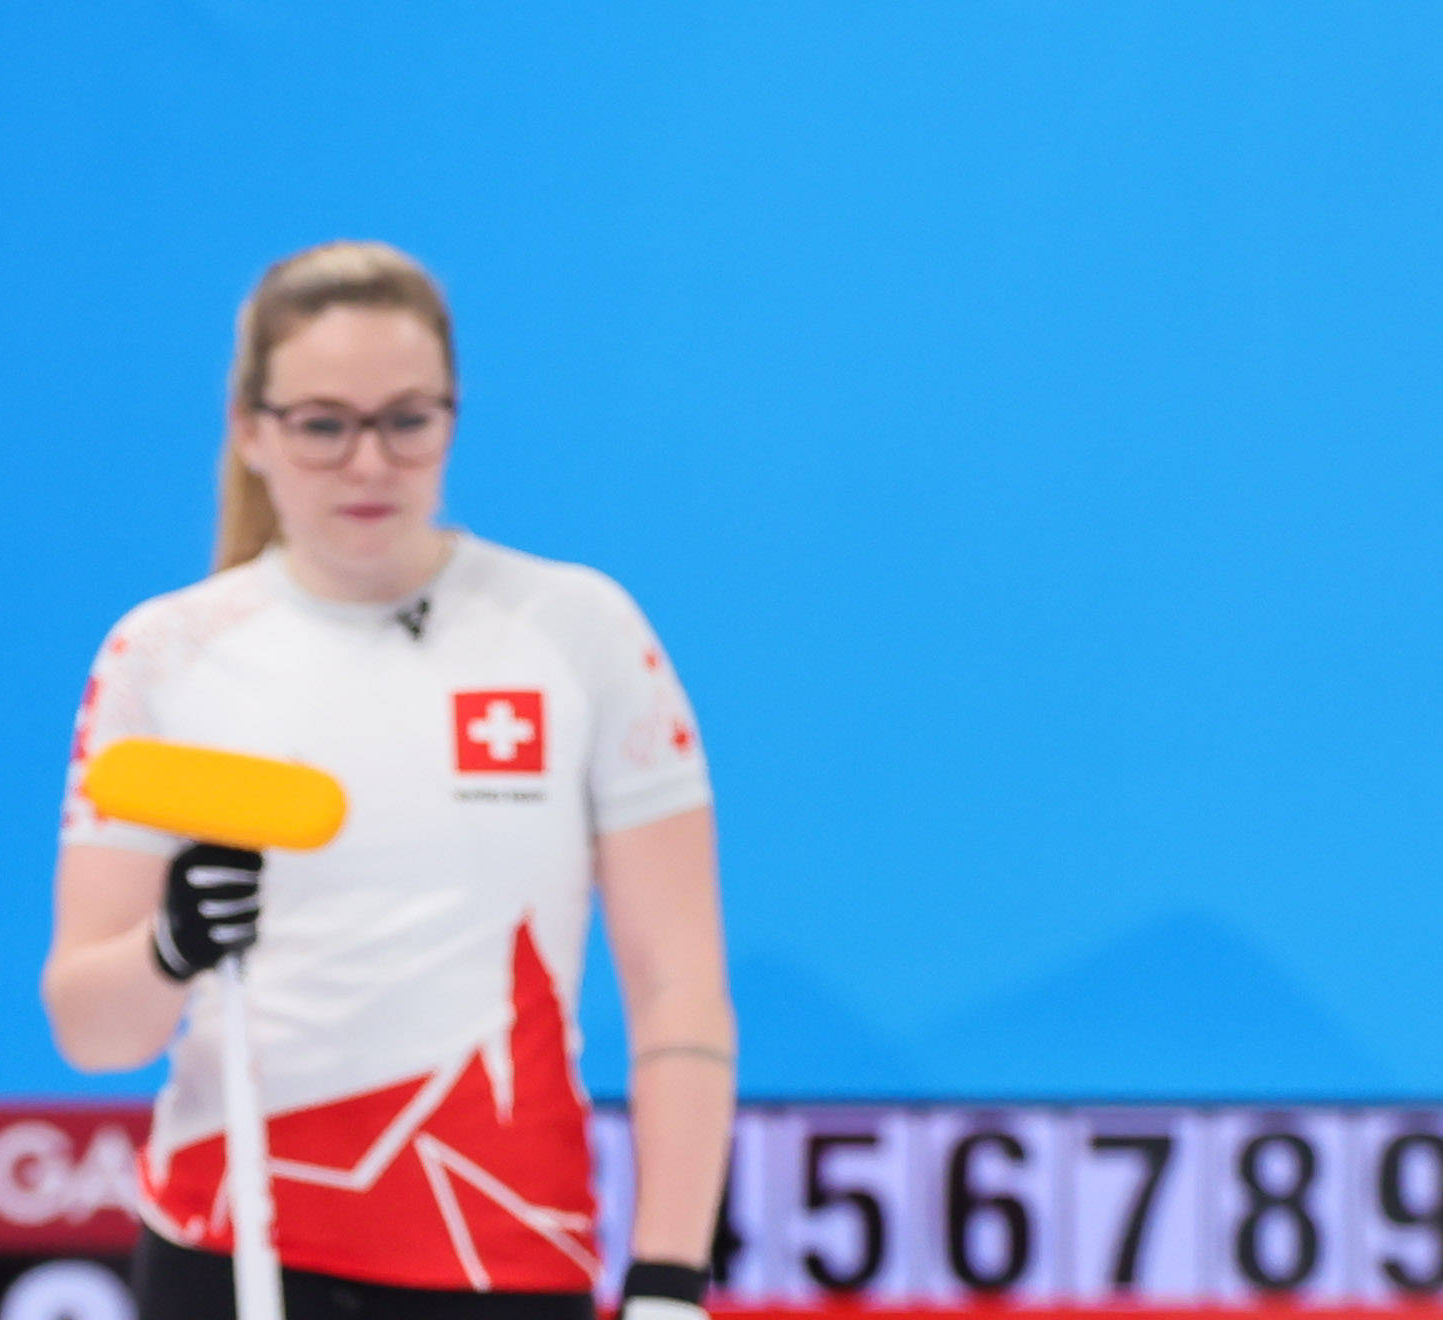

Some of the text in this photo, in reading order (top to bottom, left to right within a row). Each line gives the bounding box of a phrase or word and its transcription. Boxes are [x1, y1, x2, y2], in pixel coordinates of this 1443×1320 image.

[804, 1134, 883, 1291] 5
[947, 1132, 1029, 1291] 6
[1091, 1134, 1172, 1285] 7
[1236, 1132, 1318, 1291] 8
[1380, 1132, 1443, 1291] 9
